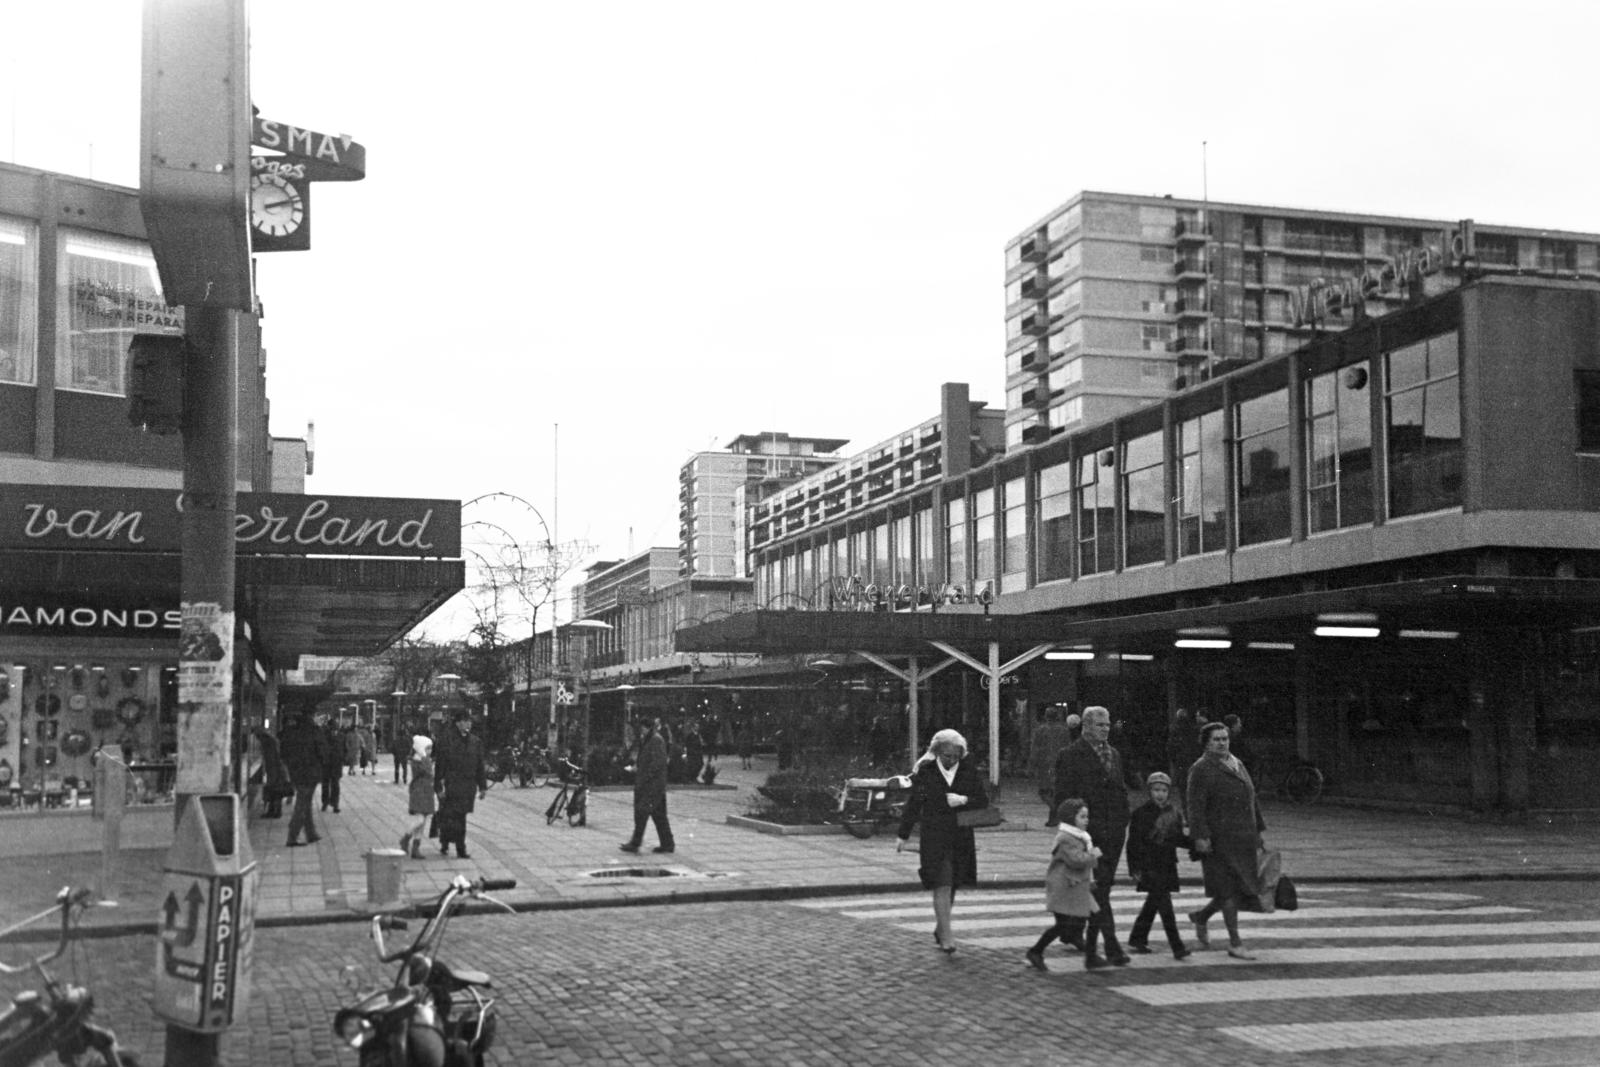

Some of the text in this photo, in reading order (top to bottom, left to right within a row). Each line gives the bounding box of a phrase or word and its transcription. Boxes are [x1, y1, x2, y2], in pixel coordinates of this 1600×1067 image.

[126, 306, 184, 328] REPARA
[24, 503, 145, 543] van
[212, 885, 234, 1001] PAPIER
